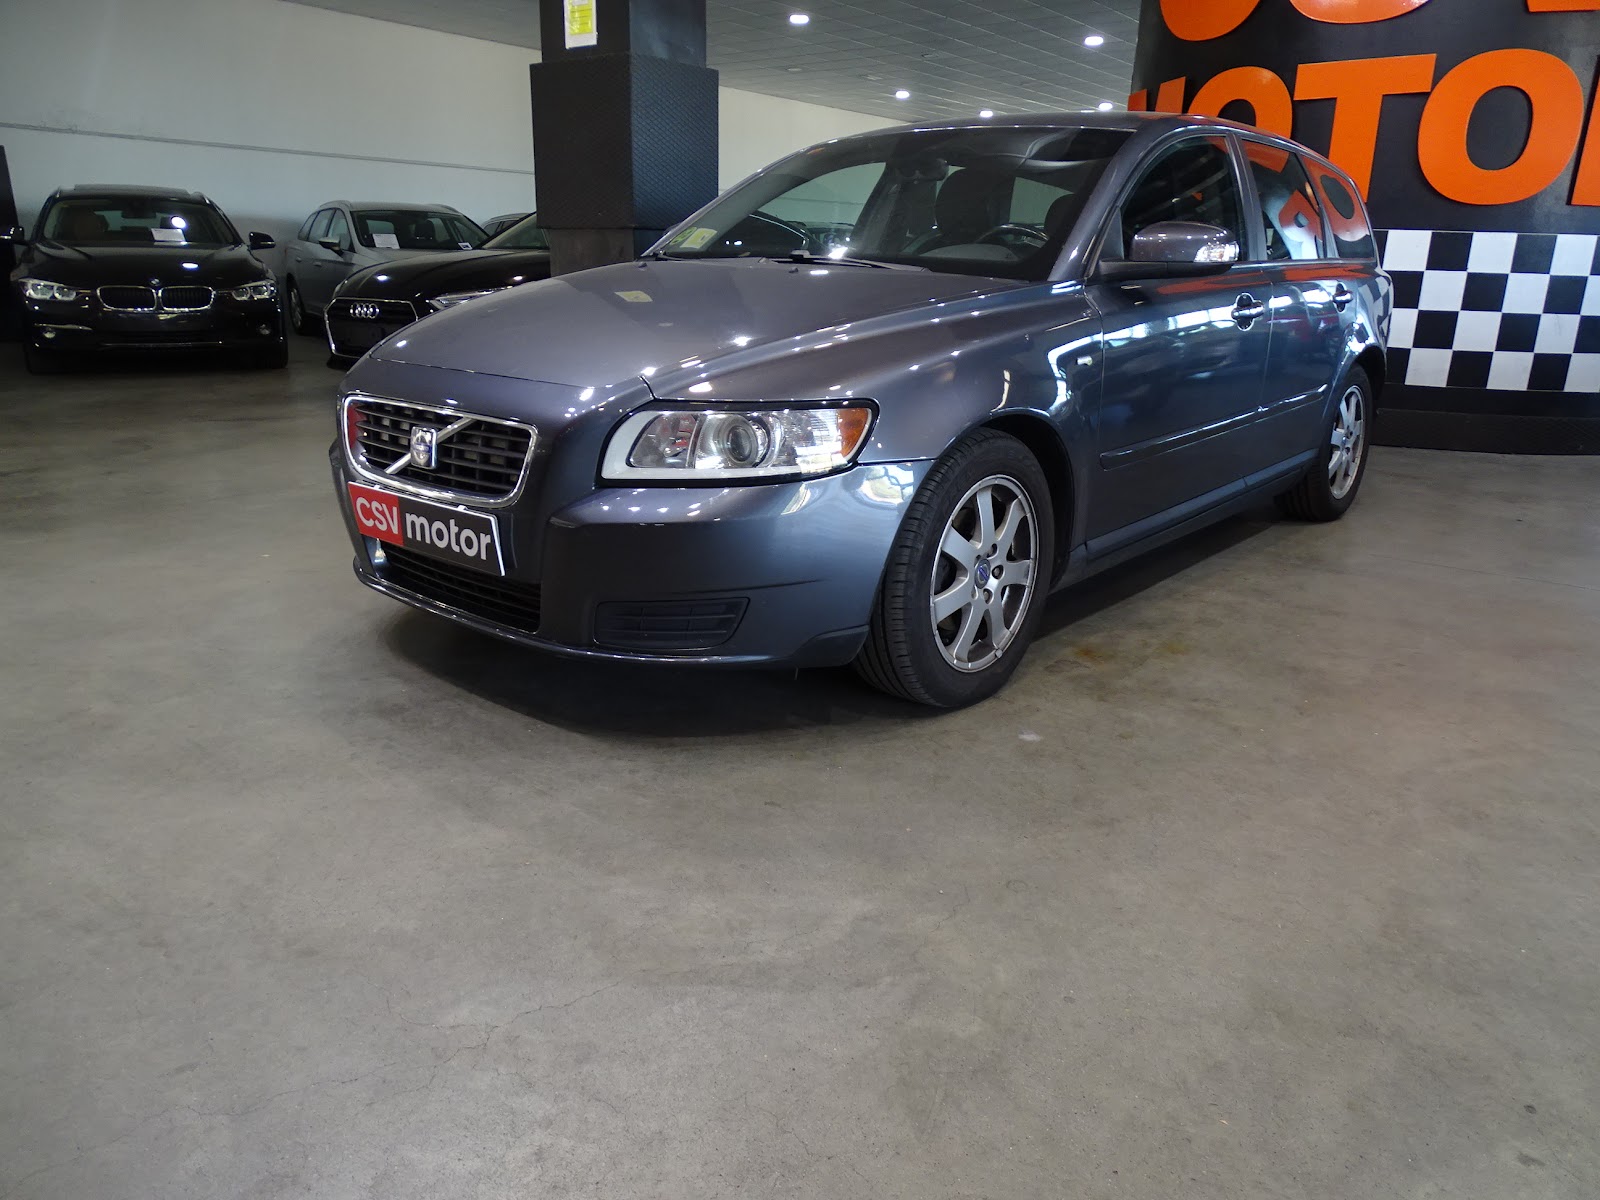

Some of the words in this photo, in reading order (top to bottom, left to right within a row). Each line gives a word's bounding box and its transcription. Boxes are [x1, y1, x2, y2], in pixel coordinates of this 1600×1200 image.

[1128, 48, 1600, 206] OTO
[356, 496, 399, 535] CSV
[405, 512, 491, 560] motor
